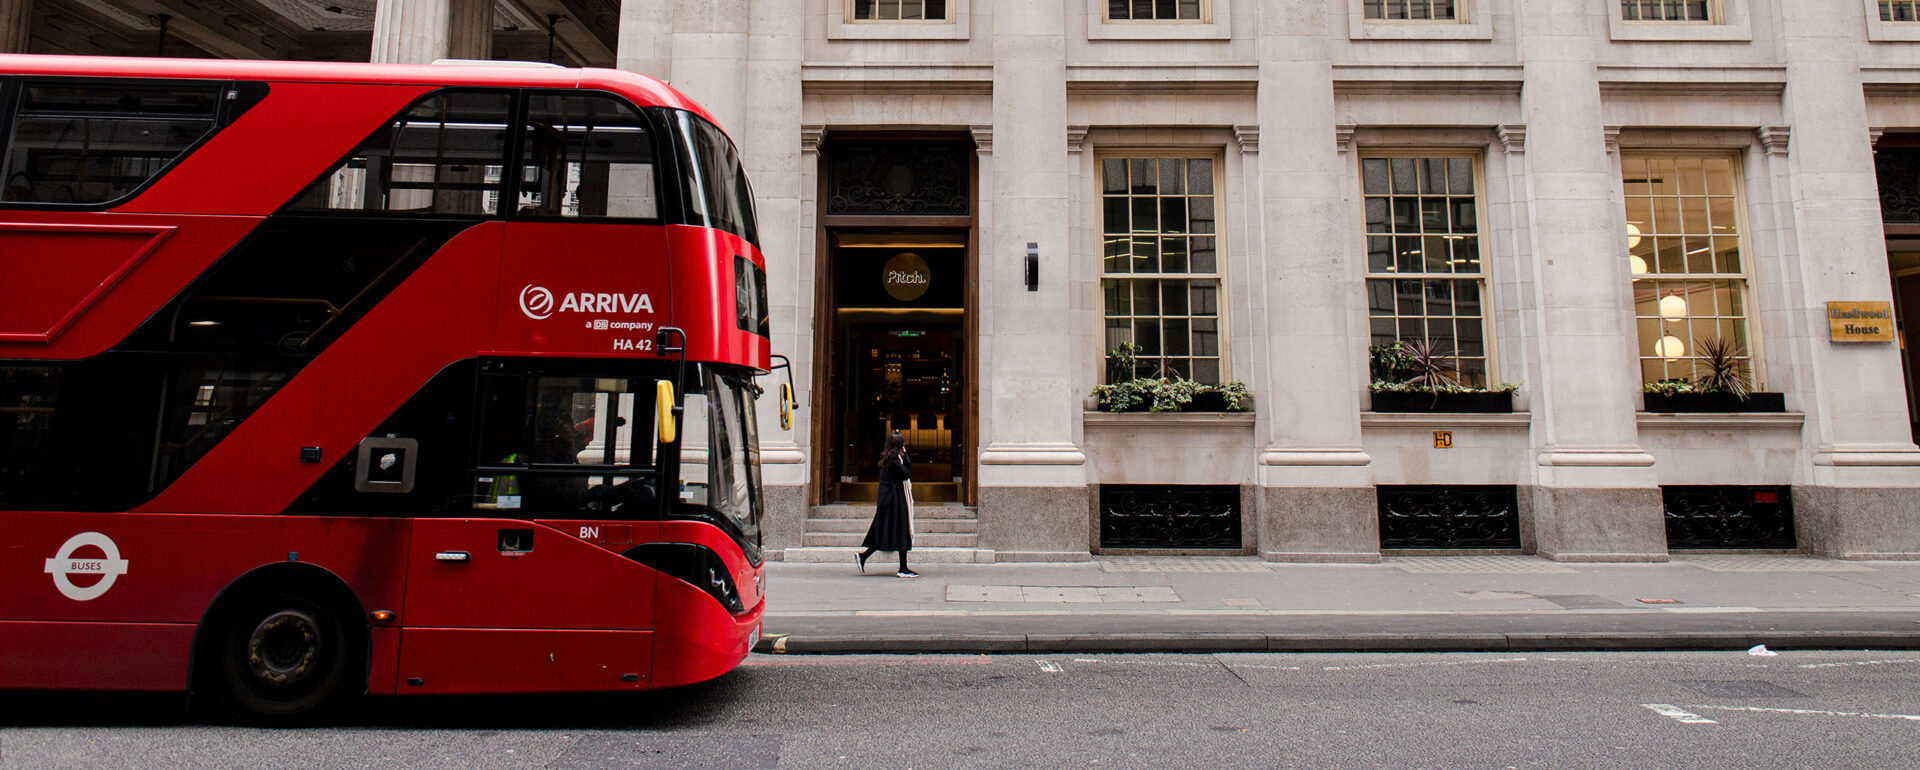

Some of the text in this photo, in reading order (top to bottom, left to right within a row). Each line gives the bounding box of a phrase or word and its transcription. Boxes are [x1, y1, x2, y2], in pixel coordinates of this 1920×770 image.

[558, 292, 655, 313] ARRIVA
[594, 320, 608, 329] DB
[610, 321, 653, 331] company
[1845, 324, 1880, 335] House
[613, 338, 652, 350] HA 42
[580, 526, 599, 539] BN
[71, 561, 102, 571] BUSES
